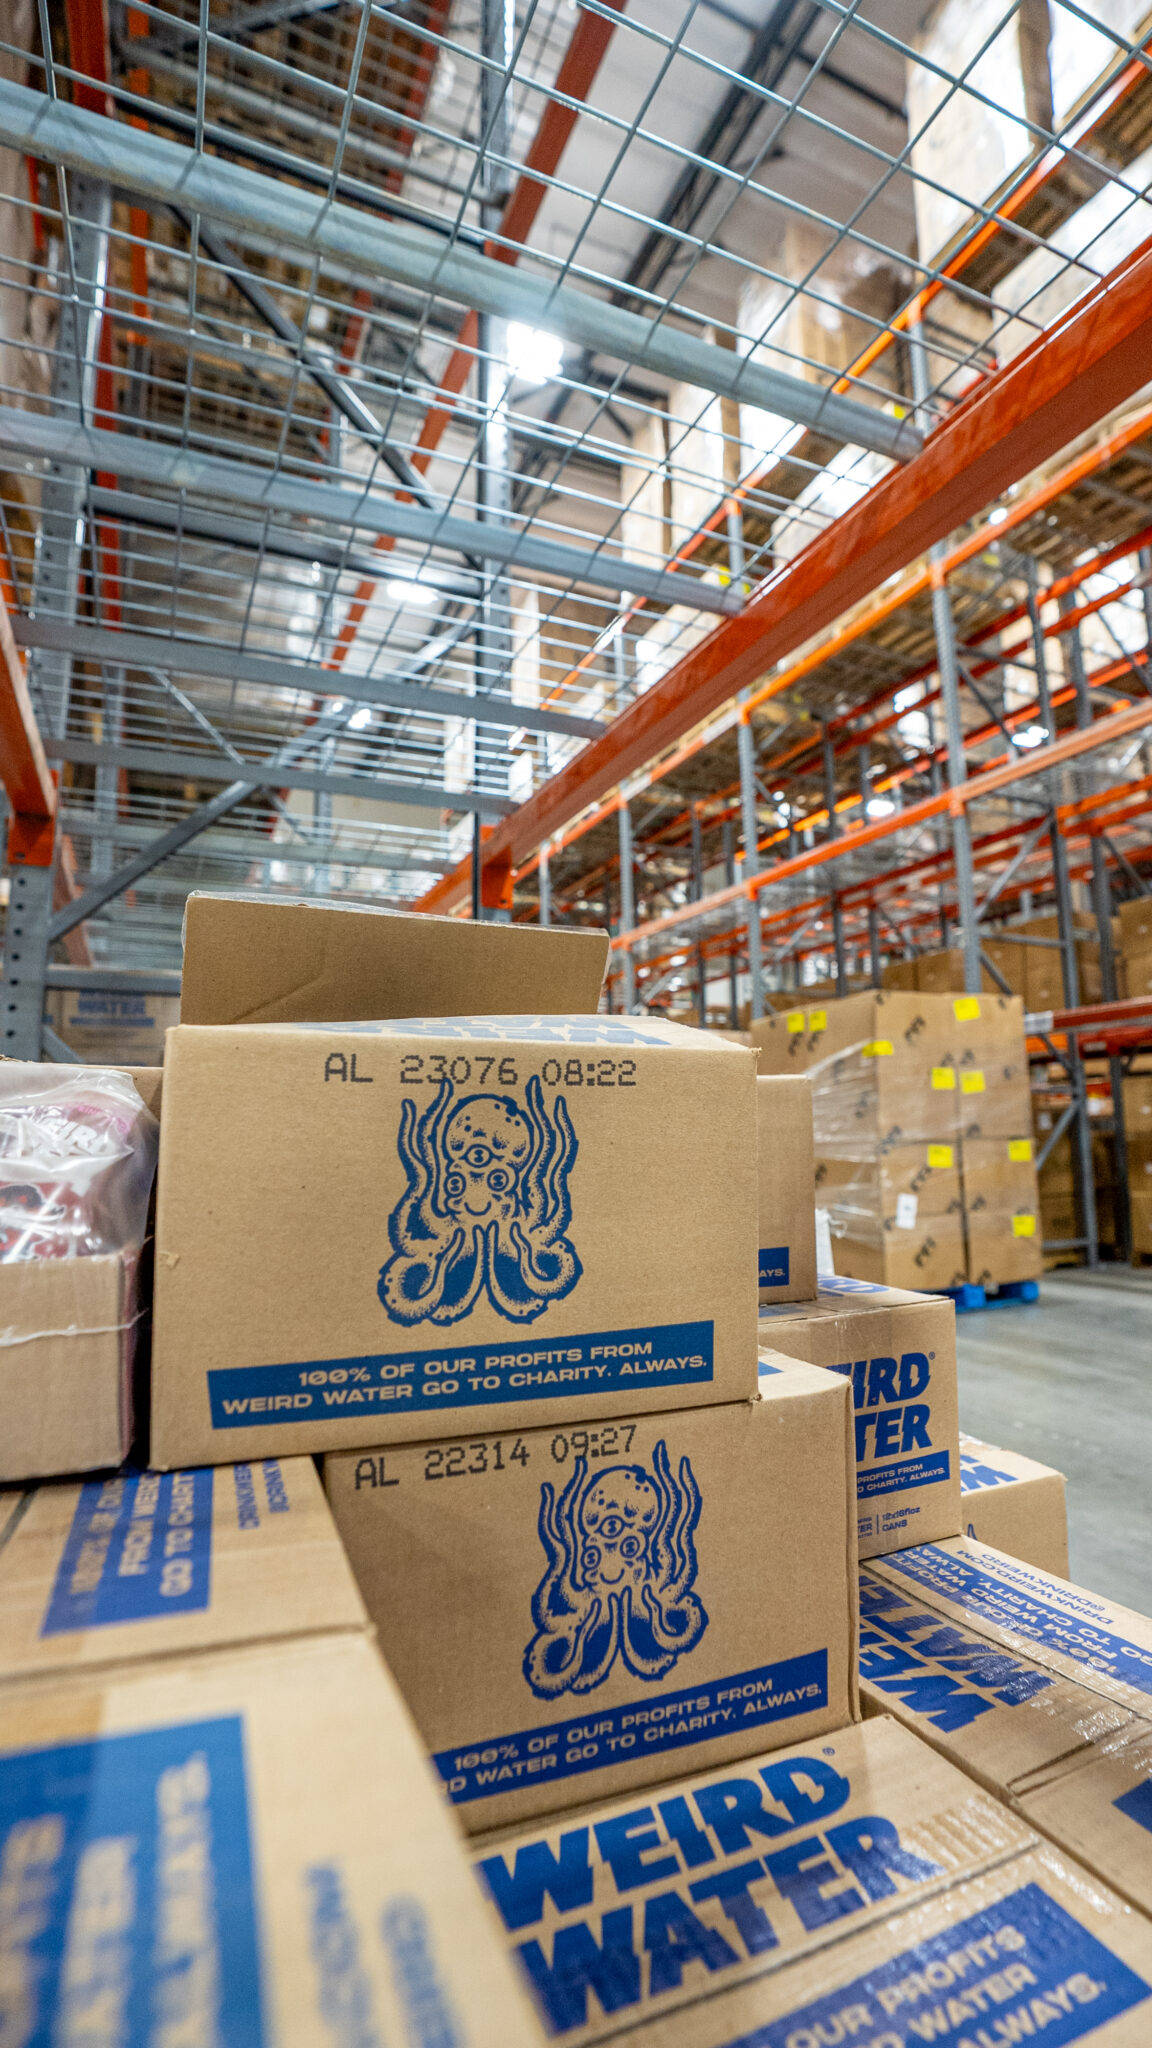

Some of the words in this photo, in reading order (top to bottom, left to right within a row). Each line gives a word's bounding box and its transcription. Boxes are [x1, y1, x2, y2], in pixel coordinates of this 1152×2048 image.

[324, 1053, 373, 1082] AL
[400, 1055, 518, 1085] 23076
[542, 1058, 636, 1086] 08:22
[222, 1394, 312, 1415] WEIRD
[322, 1384, 413, 1405] WATER
[422, 1380, 459, 1395] GO
[468, 1375, 500, 1390] TO
[509, 1365, 611, 1386] CHARITY.
[619, 1355, 707, 1375] ALWAYS.
[299, 1367, 371, 1386] 100%
[380, 1363, 415, 1379] OF
[424, 1358, 476, 1375] OUR
[485, 1348, 582, 1370] PROFITS
[590, 1342, 652, 1360] FROM
[355, 1457, 399, 1490] AL
[424, 1438, 530, 1480] 22314
[551, 1424, 637, 1463] 09:27
[857, 1469, 895, 1483] PROFITS
[898, 1464, 923, 1475] FROM
[867, 1477, 907, 1490] CHARITY.
[882, 1520, 907, 1531] CANS
[904, 1551, 966, 1586] WATER
[956, 1550, 1114, 1625] DRINKWEIRD.COM
[982, 1553, 1105, 1612] @DRINKWEIRD
[971, 1588, 1038, 1623] WEIRD
[979, 1578, 1072, 1626] CHARITY.
[1044, 1624, 1117, 1659] FROM
[1078, 1628, 1111, 1645] TO
[455, 1744, 519, 1771] 100%
[527, 1733, 559, 1753] OF
[567, 1720, 613, 1743] OUR
[621, 1696, 710, 1729] PROFITS
[717, 1679, 773, 1704] FROM
[475, 1754, 557, 1785] WATER
[565, 1743, 599, 1763] GO
[606, 1733, 636, 1751] TO
[644, 1707, 737, 1741] CHARITY.
[744, 1683, 822, 1716] ALWAYS.
[510, 1815, 946, 2038] WATER
[876, 1924, 1027, 2016] PROFITS
[907, 1963, 1038, 2041] WATER
